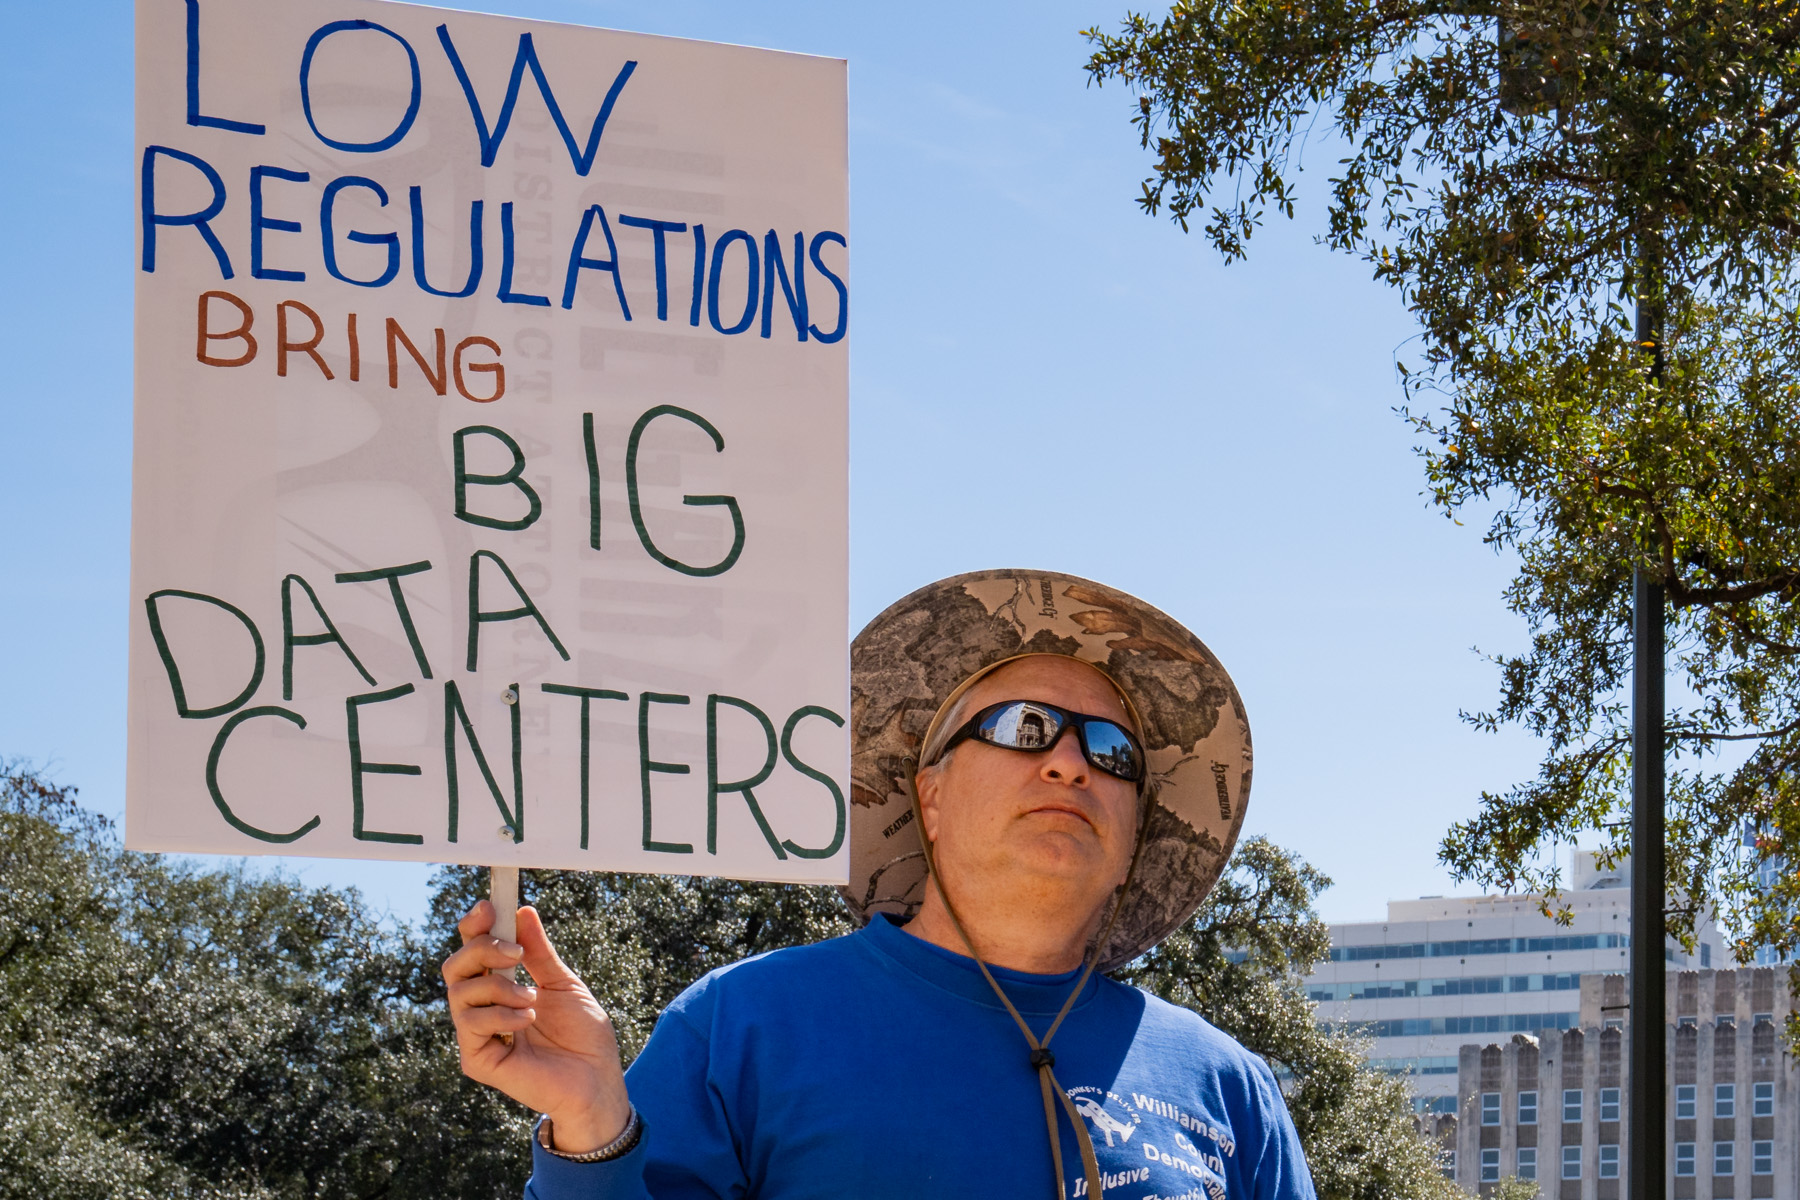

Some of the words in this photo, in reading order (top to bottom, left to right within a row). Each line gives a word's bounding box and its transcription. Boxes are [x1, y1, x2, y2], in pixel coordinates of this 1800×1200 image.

[186, 0, 638, 176] LOW
[142, 145, 847, 344] REGULATIONS
[197, 291, 506, 403] BRING
[453, 404, 745, 577] BIG
[145, 550, 570, 718] DATA
[206, 680, 846, 861] CENTERS
[882, 807, 915, 839] WEATHER
[1073, 1166, 1150, 1198] Inlusive
[1132, 1092, 1236, 1158] Williamson
